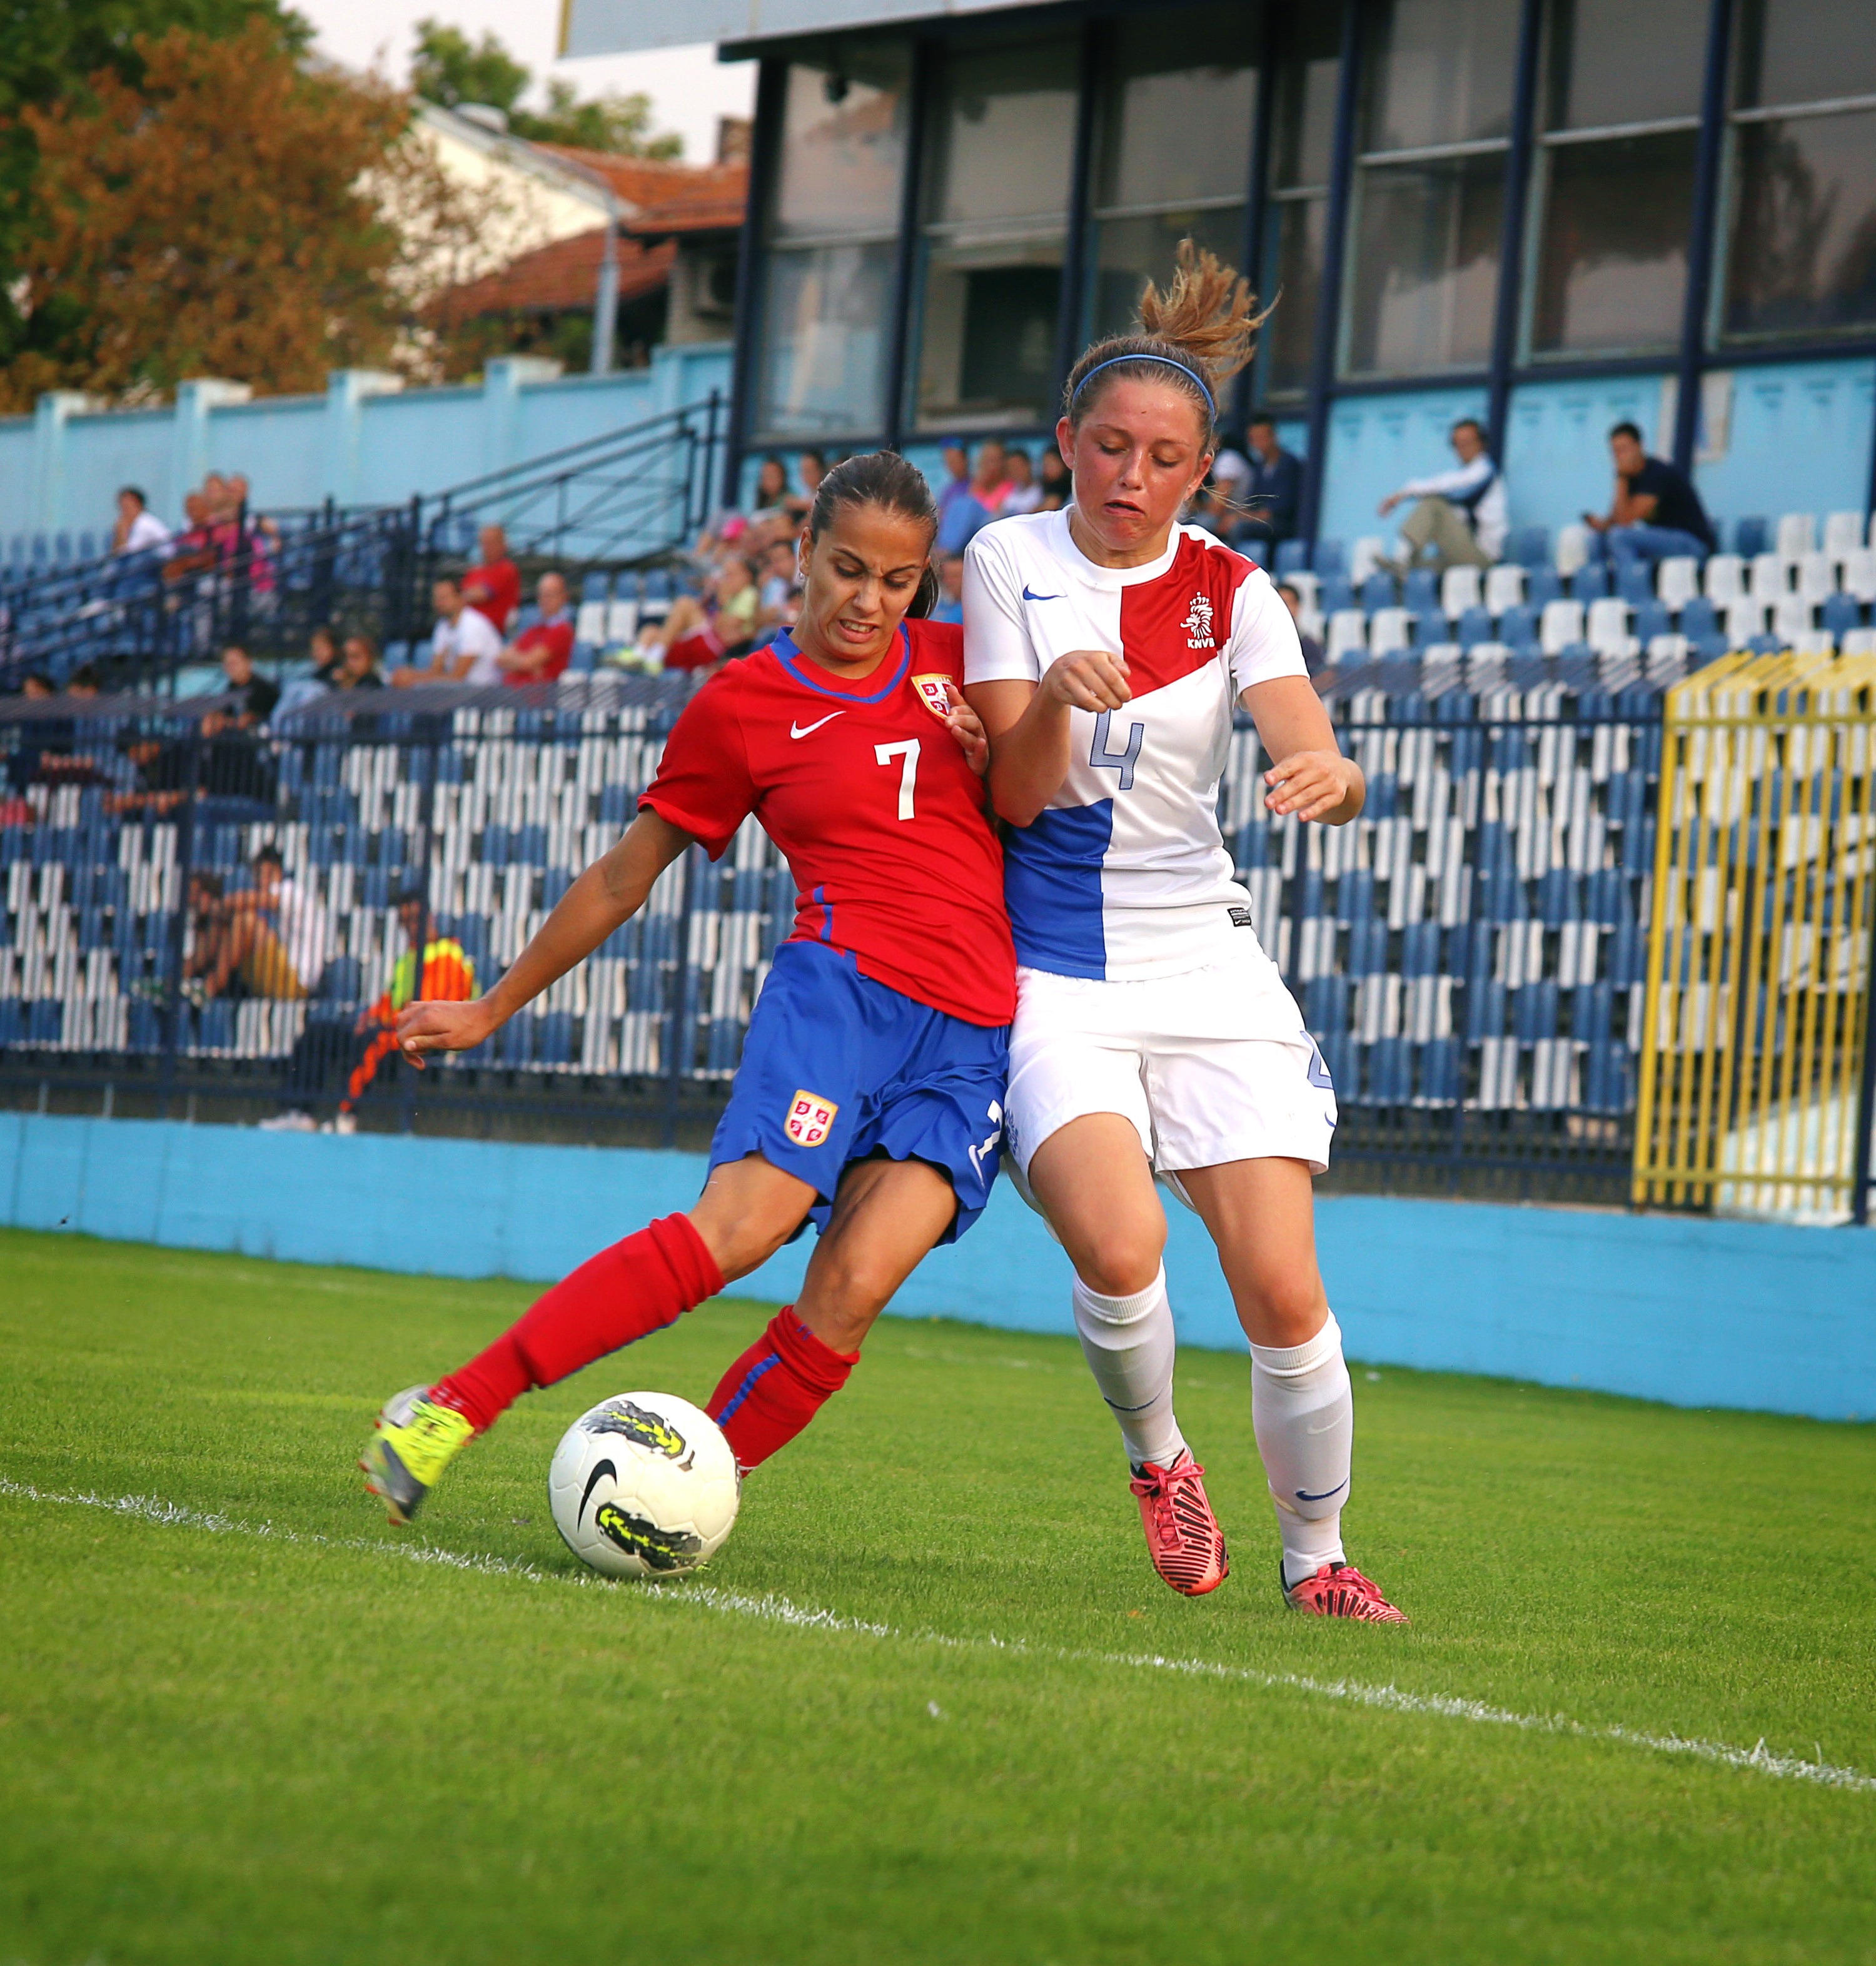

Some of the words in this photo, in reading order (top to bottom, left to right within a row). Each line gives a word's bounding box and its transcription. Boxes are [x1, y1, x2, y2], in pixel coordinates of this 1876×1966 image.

[1187, 637, 1215, 649] KNVB
[874, 738, 921, 821] 7
[1089, 708, 1144, 790] 4
[977, 1099, 1003, 1161] 7
